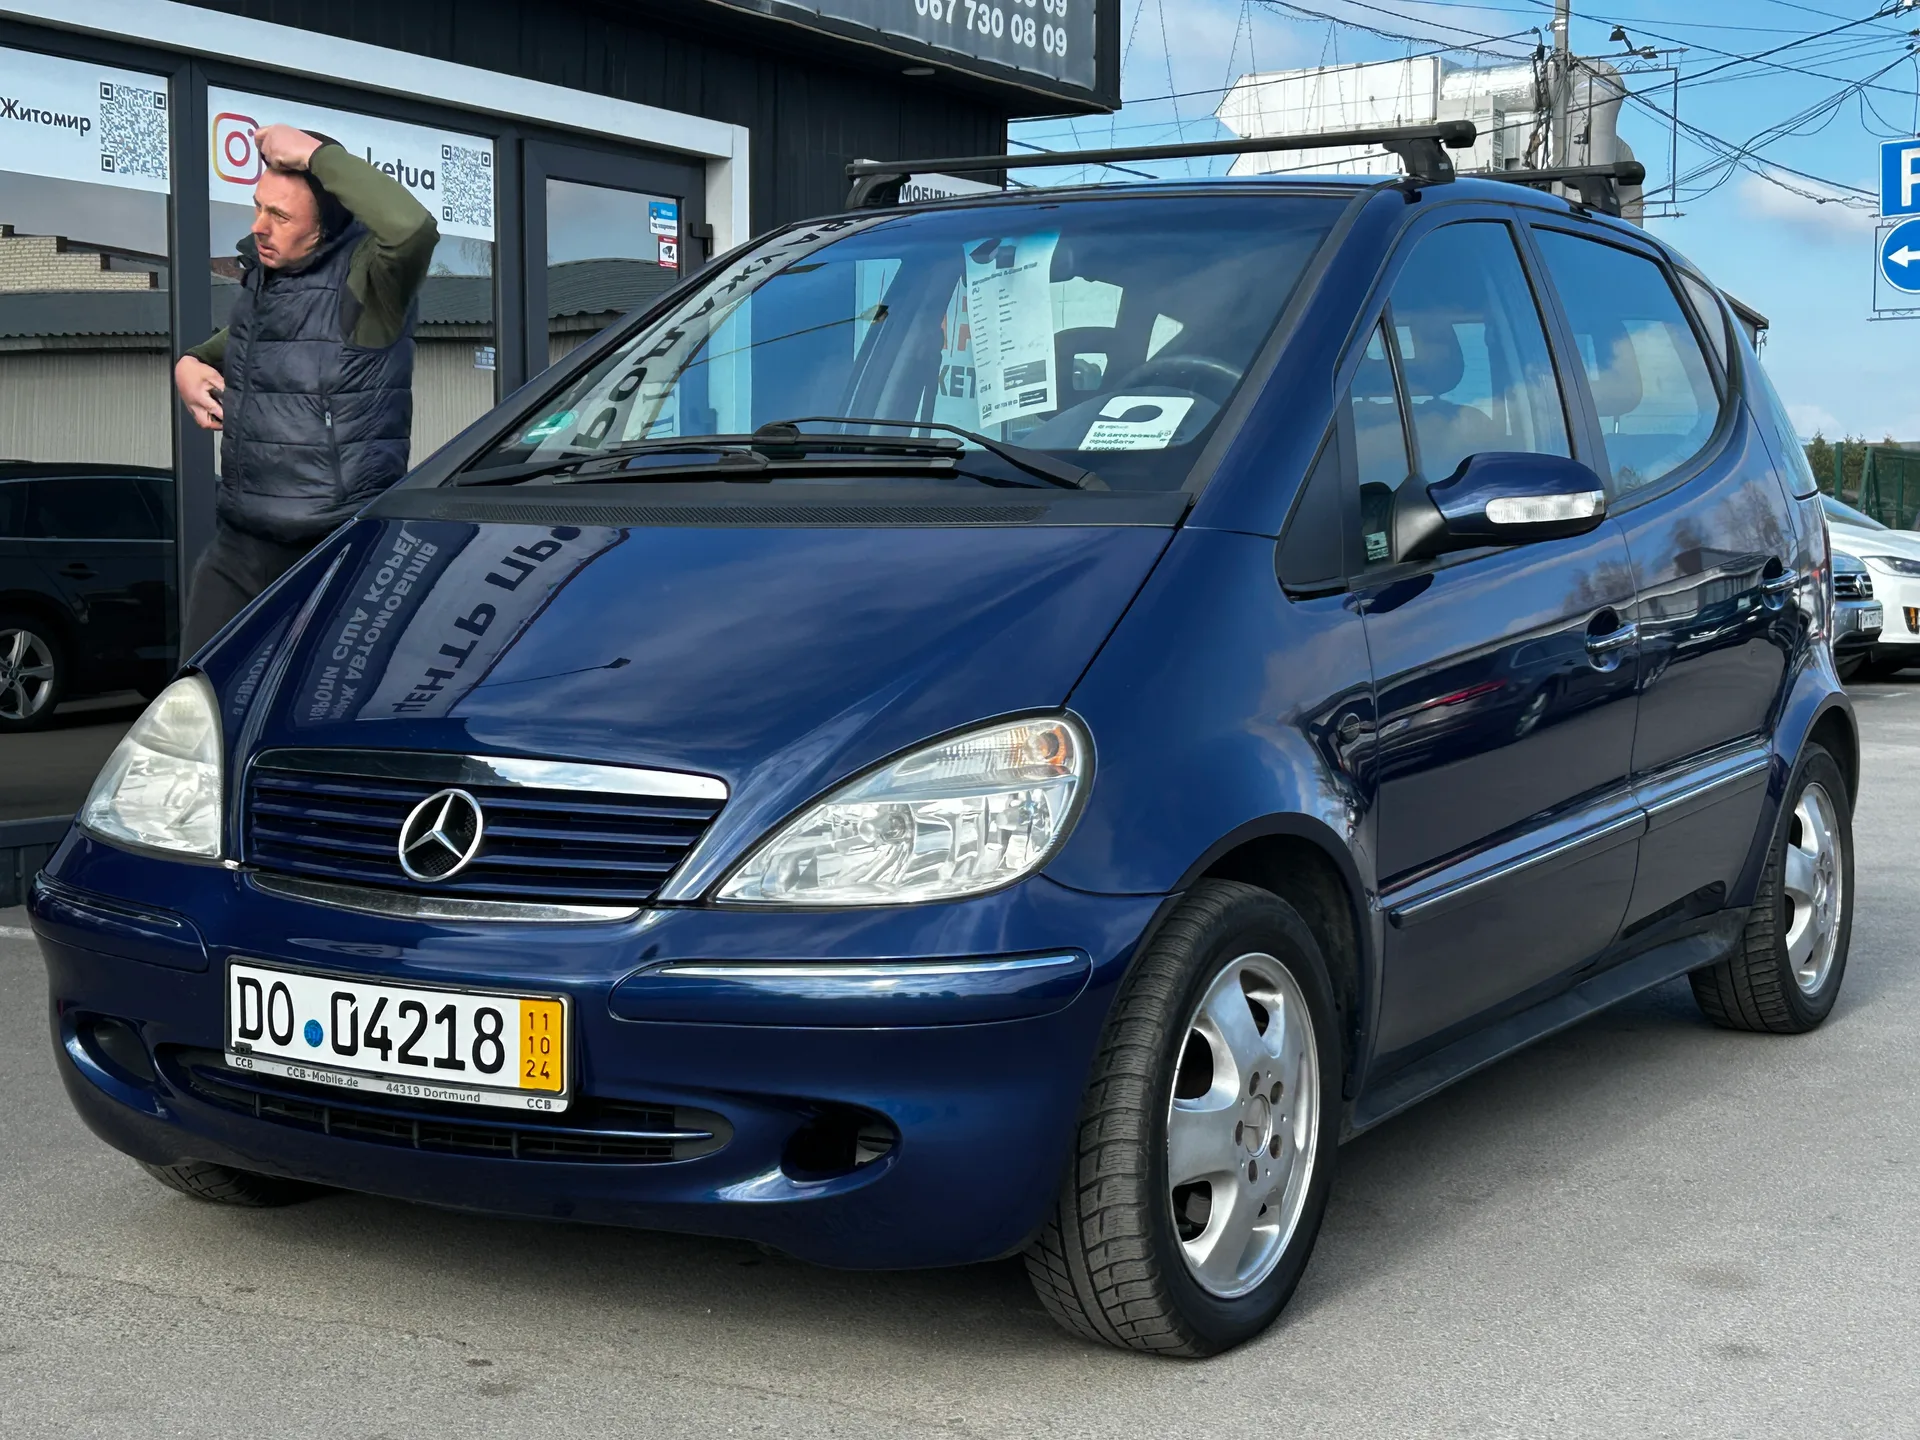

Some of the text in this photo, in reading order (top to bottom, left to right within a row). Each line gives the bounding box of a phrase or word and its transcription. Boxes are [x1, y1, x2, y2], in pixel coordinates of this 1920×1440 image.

[915, 0, 1067, 57] 067 730 08 09
[0, 96, 91, 137] Житомир
[237, 976, 505, 1074] DO 04218
[528, 1012, 549, 1031] 11
[528, 1036, 550, 1054] 10
[235, 1057, 253, 1069] CCB
[526, 1060, 550, 1079] 24
[386, 1083, 420, 1096] 44319
[423, 1088, 480, 1103] Dortmund
[526, 1098, 552, 1110] CCB
